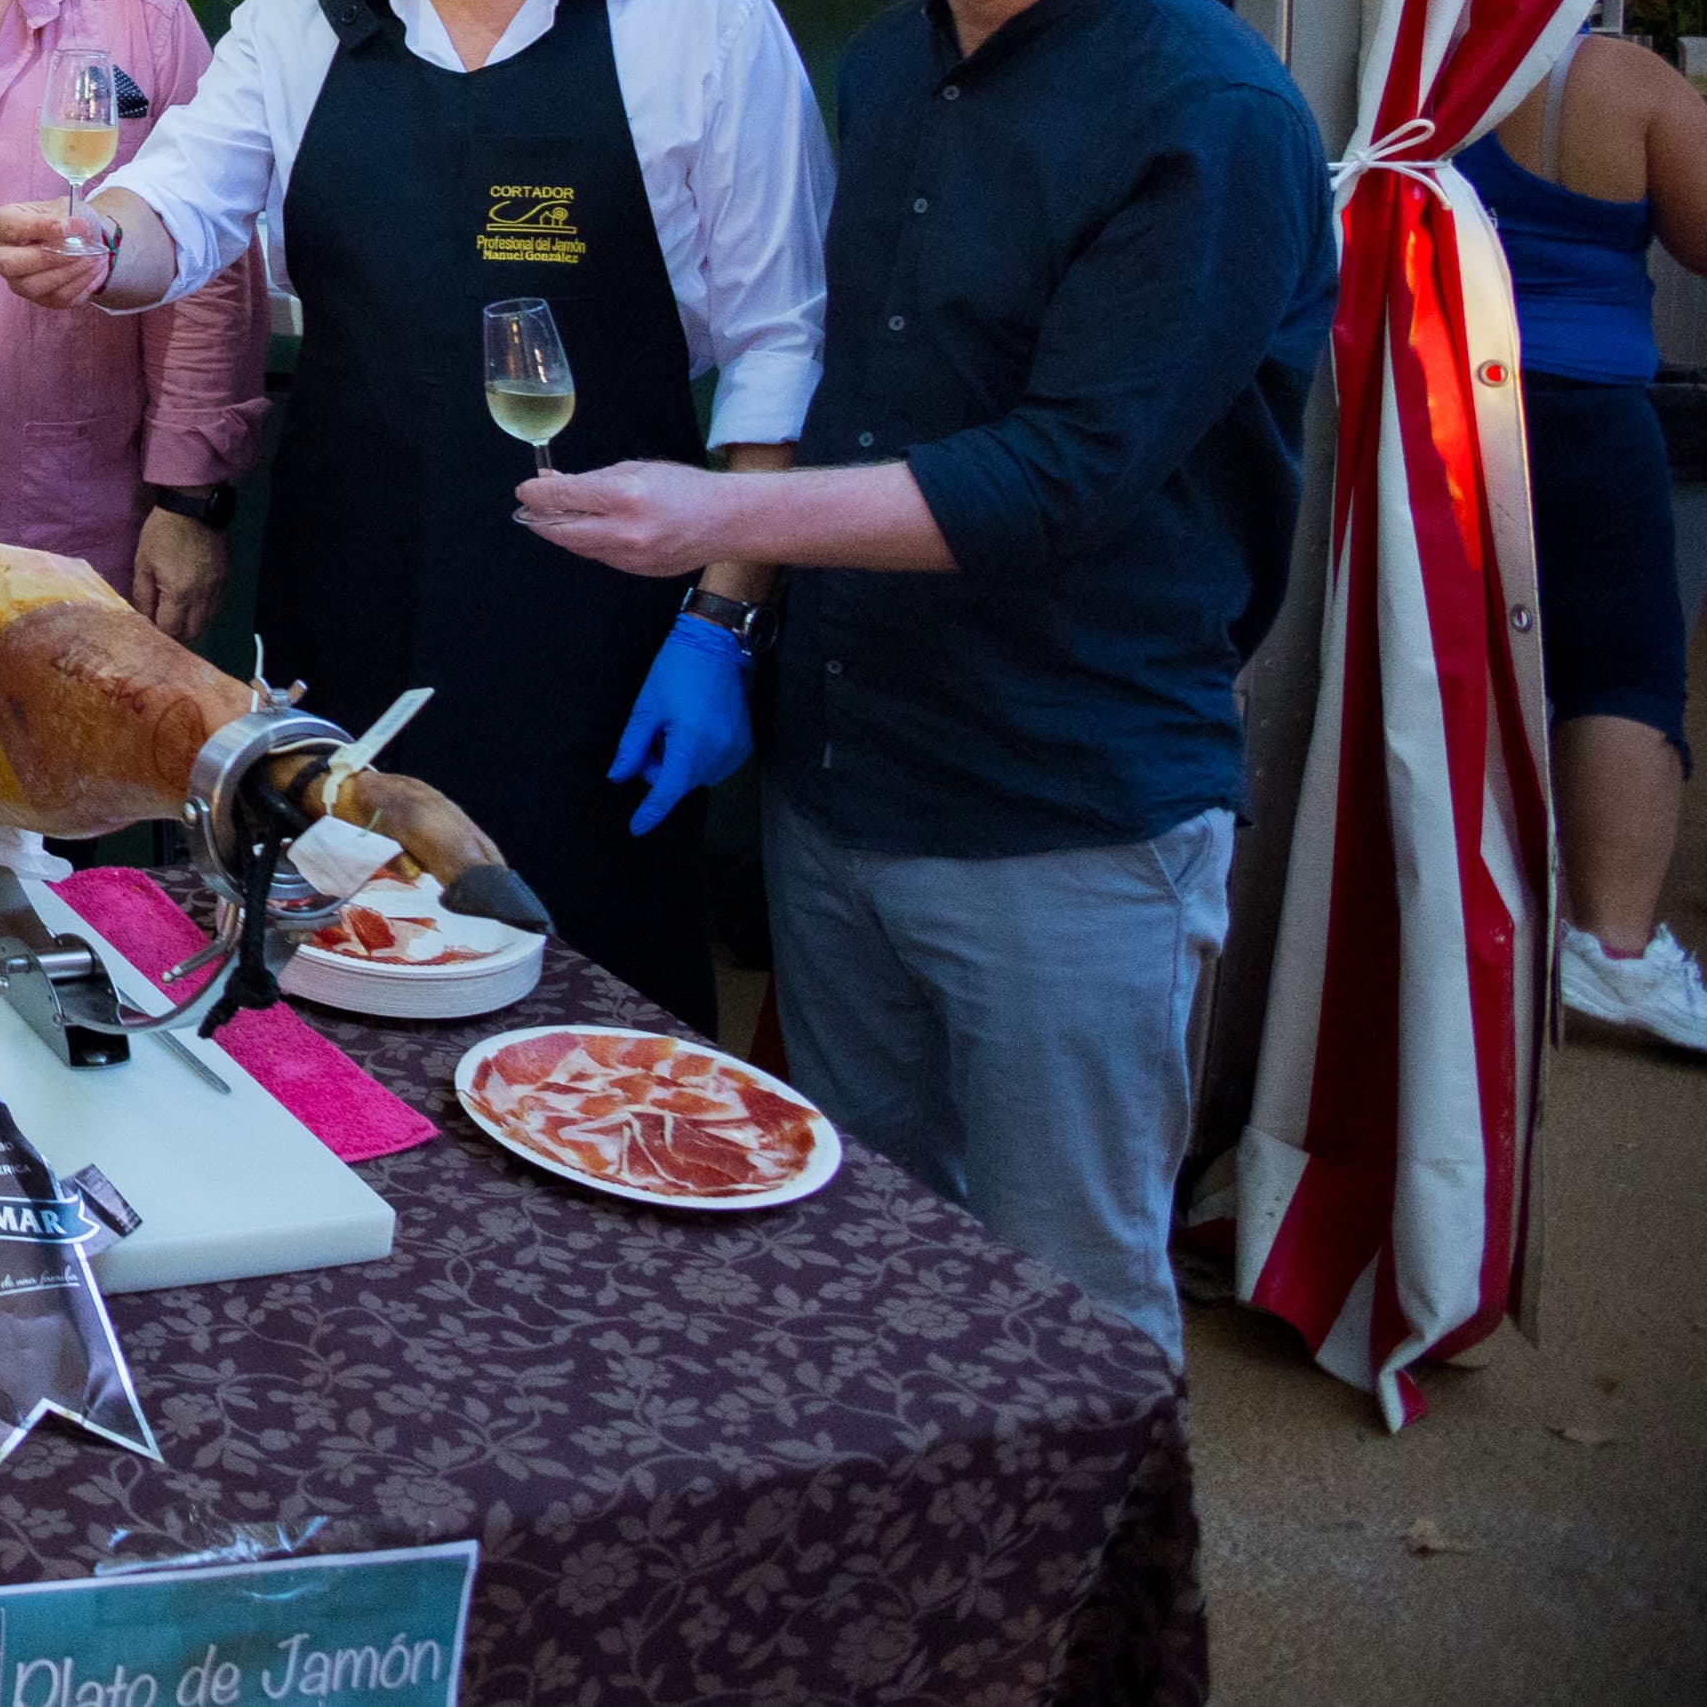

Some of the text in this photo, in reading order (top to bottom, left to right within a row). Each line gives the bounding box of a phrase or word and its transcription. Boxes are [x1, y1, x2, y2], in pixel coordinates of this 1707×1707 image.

[489, 185, 575, 199] CORTADOR
[476, 234, 586, 254] Profesional del Jamón
[483, 249, 523, 262] Manuel
[14, 1632, 441, 1707] Plato de Jamón
